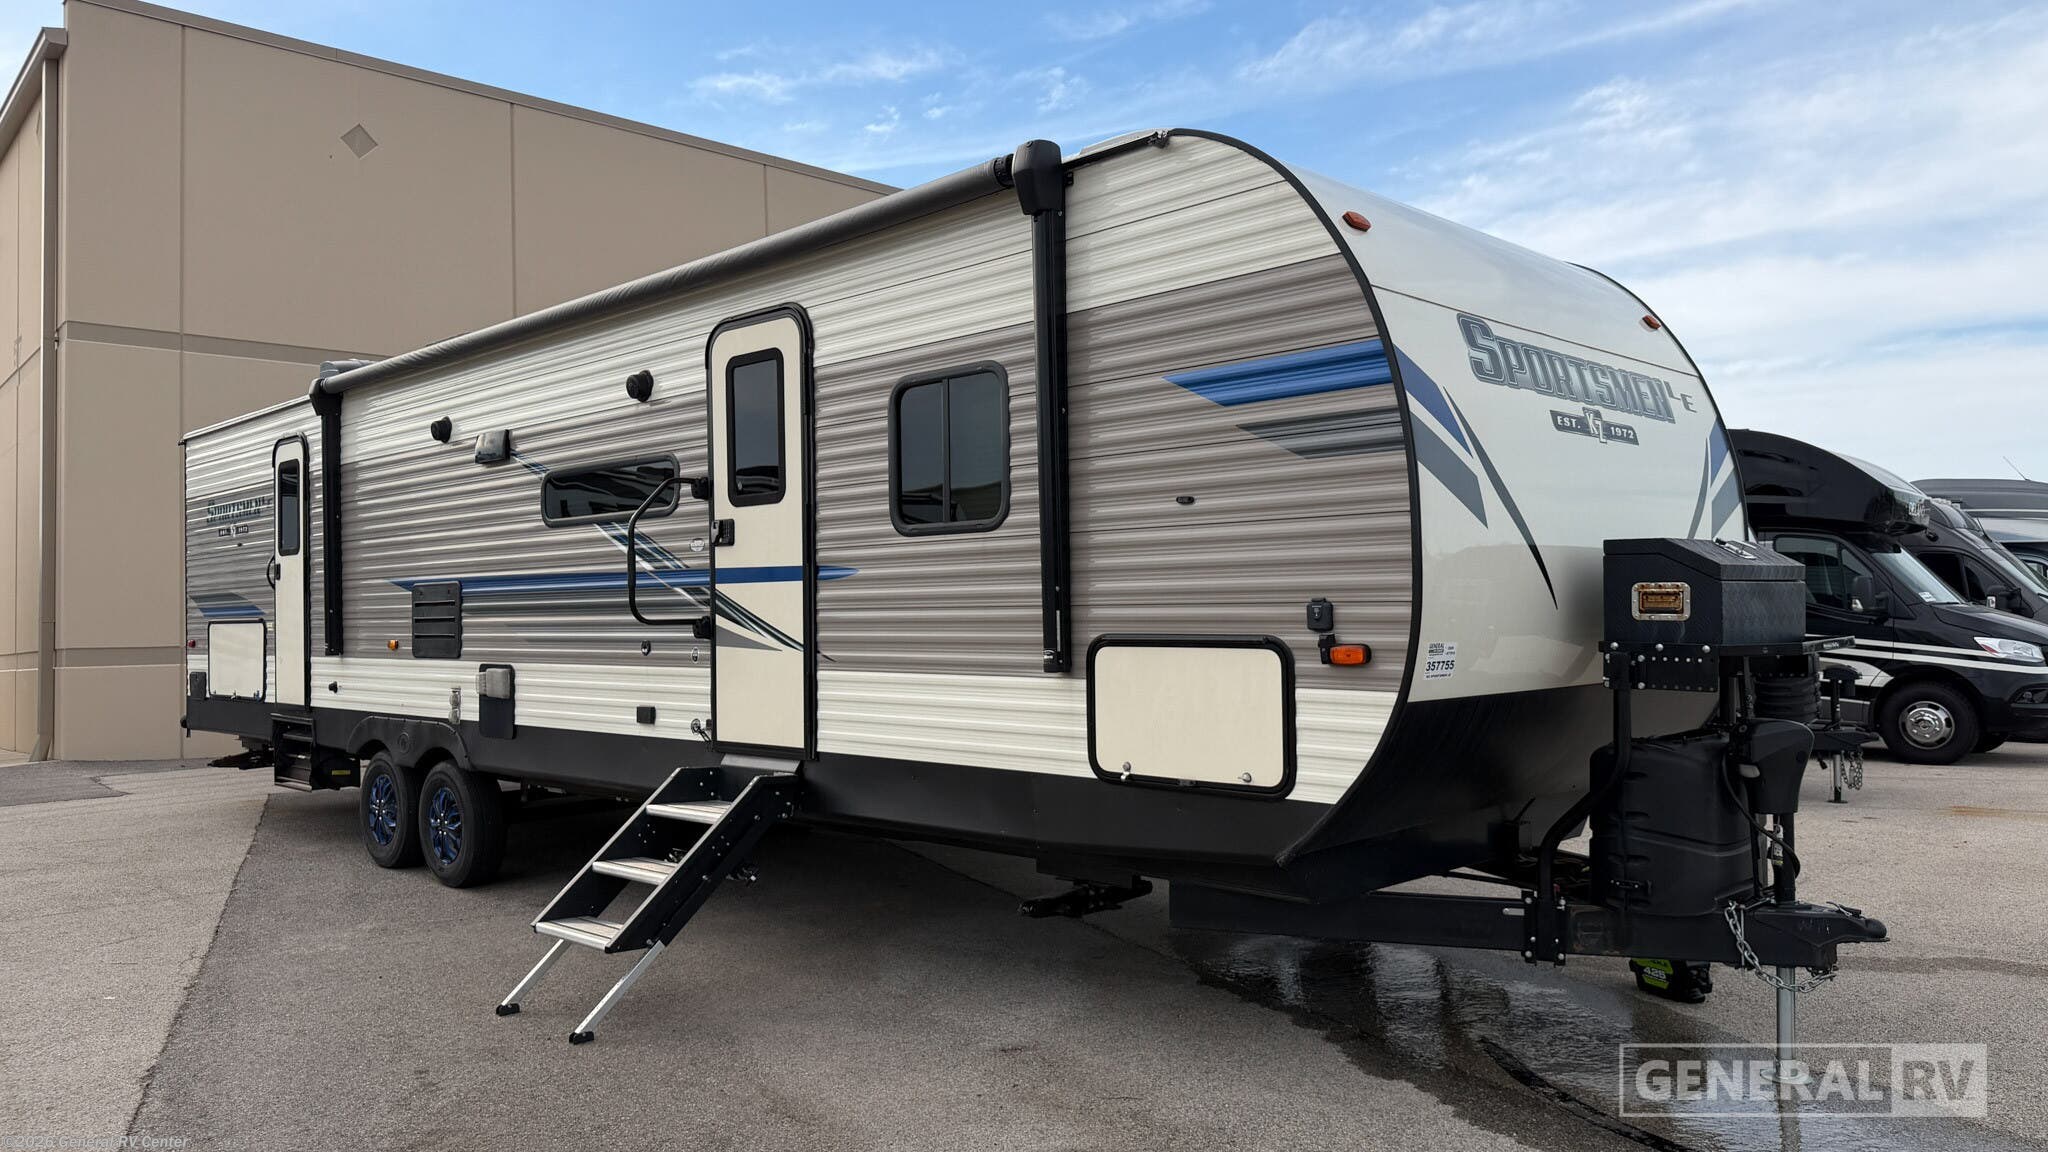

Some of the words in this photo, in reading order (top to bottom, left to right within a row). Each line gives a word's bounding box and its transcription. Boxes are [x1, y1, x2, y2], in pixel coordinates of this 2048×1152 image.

[1457, 313, 1675, 424] SPORTSMEN
[1557, 415, 1581, 429] EST.
[1610, 426, 1634, 439] 1972
[1426, 660, 1455, 671] 357755
